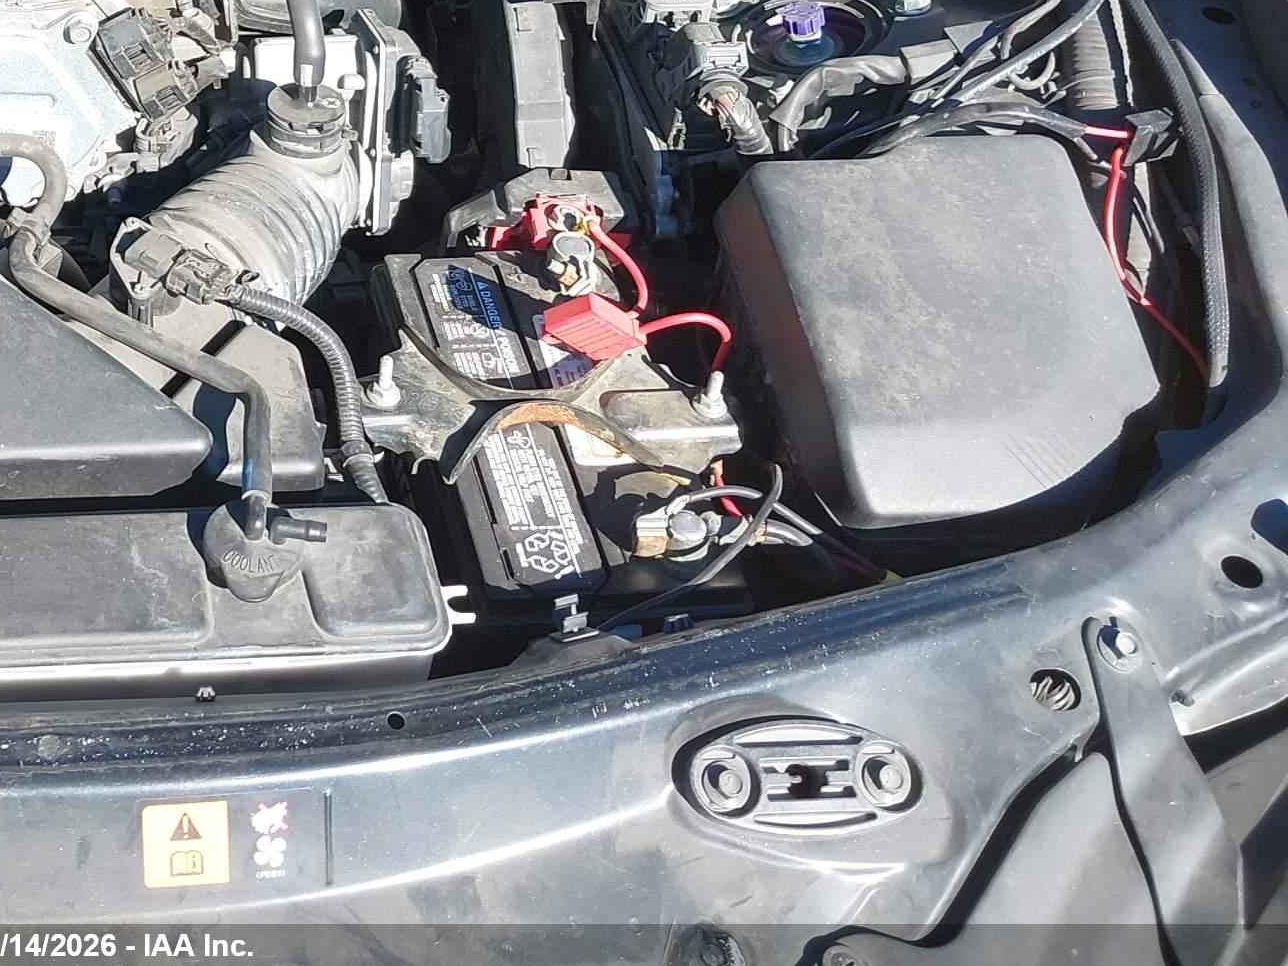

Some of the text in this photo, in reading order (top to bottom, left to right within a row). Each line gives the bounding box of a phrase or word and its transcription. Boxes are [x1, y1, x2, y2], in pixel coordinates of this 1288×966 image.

[480, 291, 502, 329] DANGER
[498, 338, 520, 373] POISON
[222, 549, 281, 574] COOLANT
